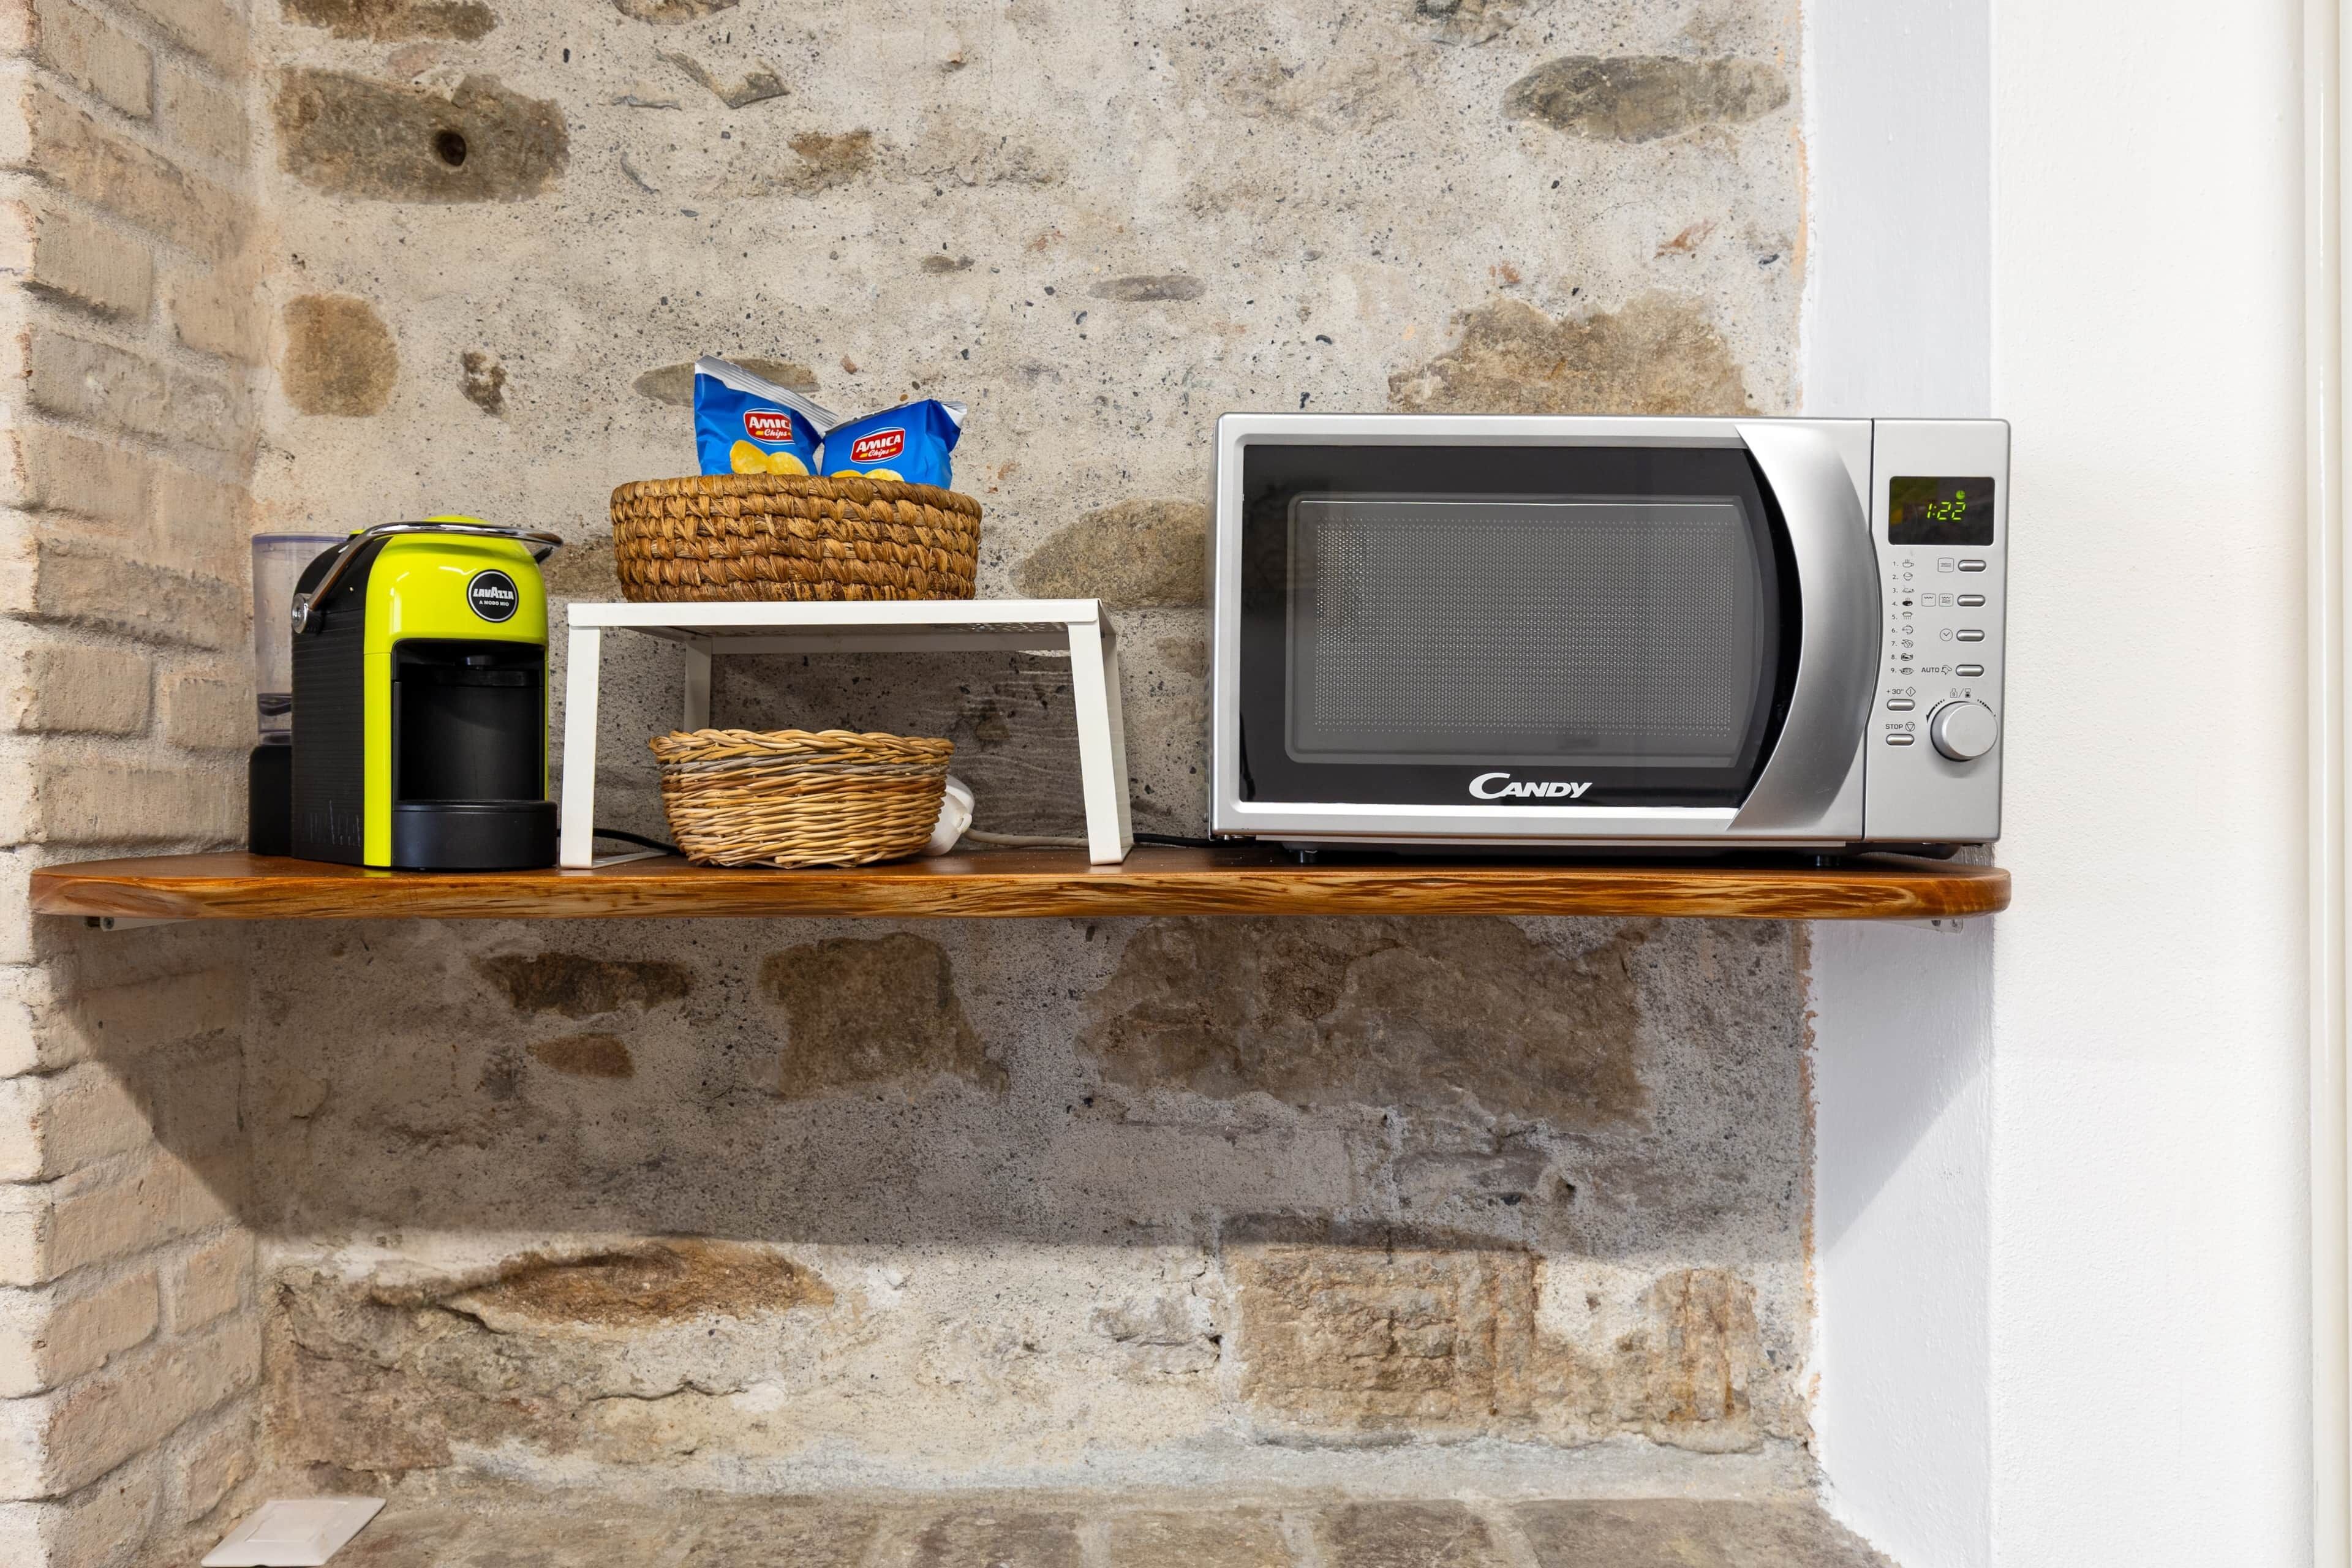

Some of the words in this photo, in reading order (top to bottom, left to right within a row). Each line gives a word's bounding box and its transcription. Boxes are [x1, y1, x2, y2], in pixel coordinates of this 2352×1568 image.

[749, 417, 791, 429] AMIC
[764, 429, 788, 439] Chips
[856, 435, 901, 453] AMICA
[868, 449, 889, 458] Chips
[1927, 502, 1966, 520] 1:22
[473, 587, 514, 600] LAVAZZA
[1469, 772, 1593, 799] CANDY
